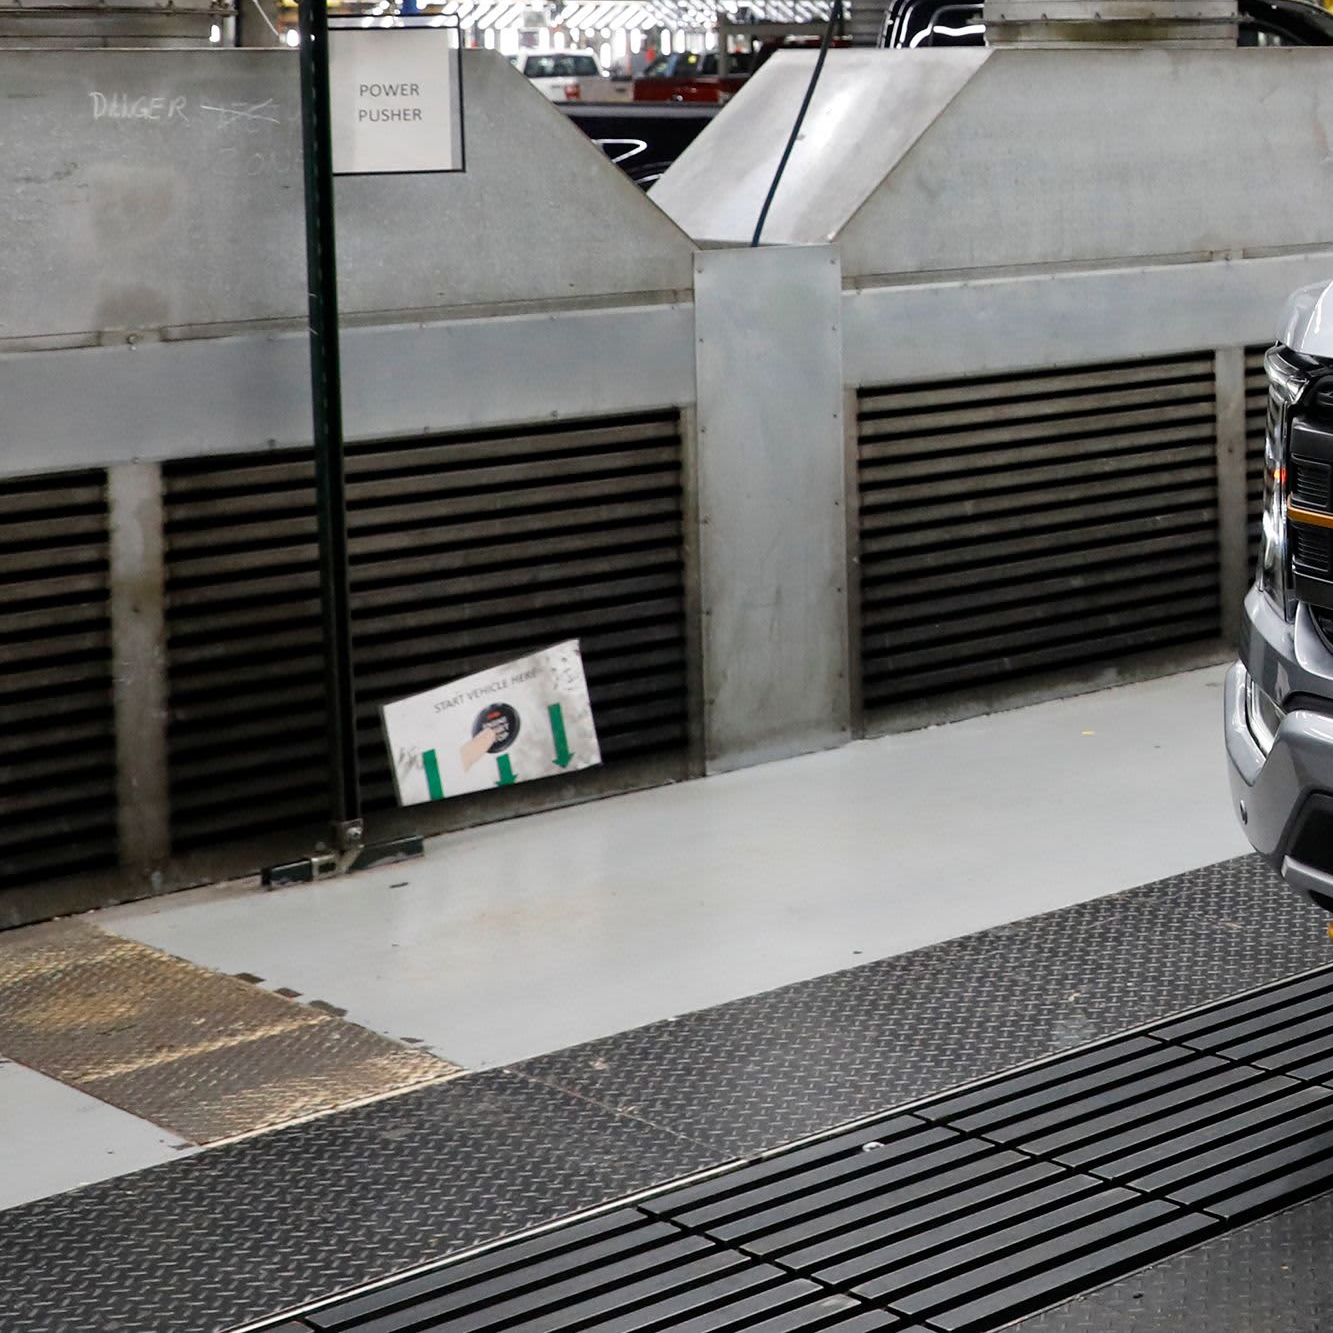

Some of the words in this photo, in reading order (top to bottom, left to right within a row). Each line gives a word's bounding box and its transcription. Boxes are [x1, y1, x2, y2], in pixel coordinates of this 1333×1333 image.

[360, 83, 420, 97] POWER
[359, 108, 422, 122] PUSHER
[433, 693, 464, 714] START
[466, 678, 508, 700] VEHICLE
[511, 667, 537, 684] HERE
